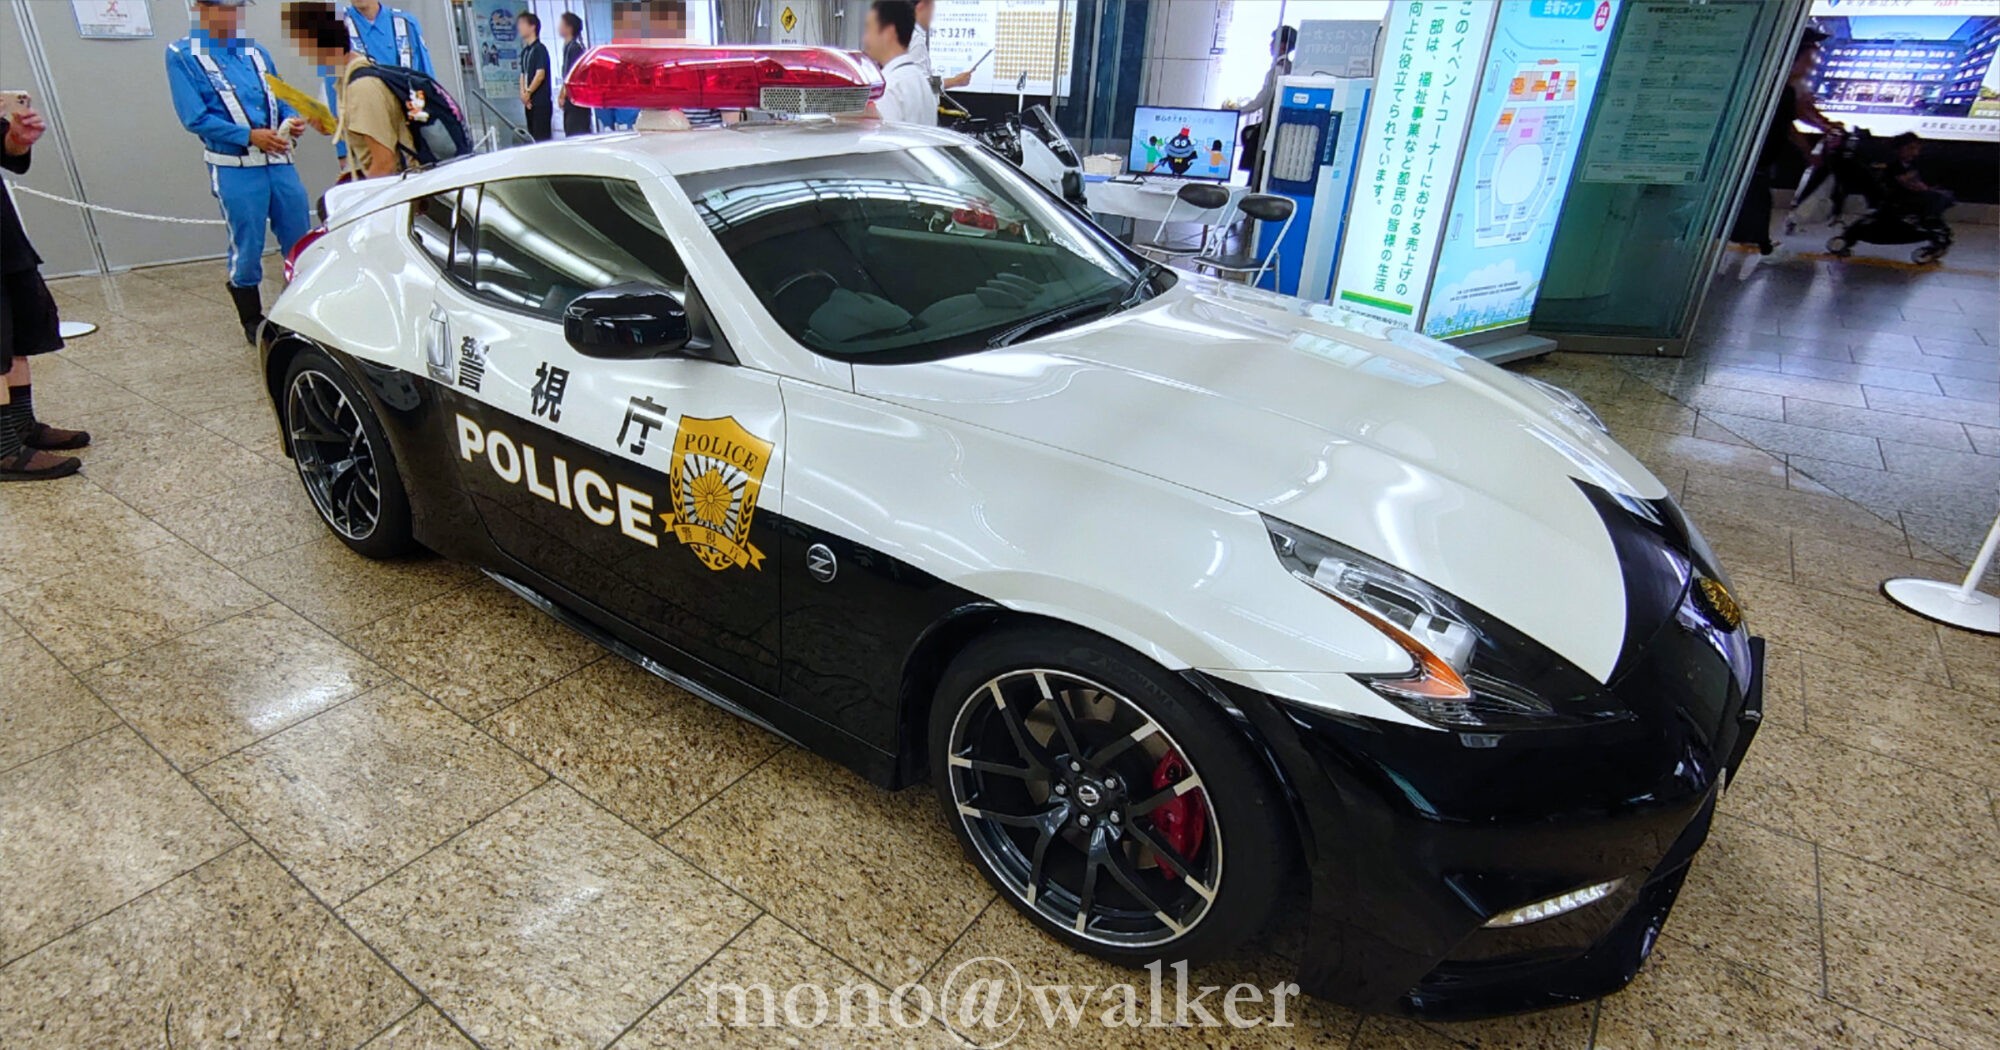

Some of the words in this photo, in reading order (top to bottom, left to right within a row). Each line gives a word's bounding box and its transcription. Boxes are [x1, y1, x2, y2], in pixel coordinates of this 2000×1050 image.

[1373, 2, 1423, 205] 向上に役立てられています。
[1373, 6, 1447, 292] 一部は、福祉事業など都民の皆様の生活
[1396, 1, 1472, 296] このイベントコーナーにおける売上げの
[1922, 122, 2000, 132] 東京都公立大学法
[457, 336, 668, 455] 警視庁
[684, 433, 760, 473] POLICE
[455, 413, 659, 549] POLICE
